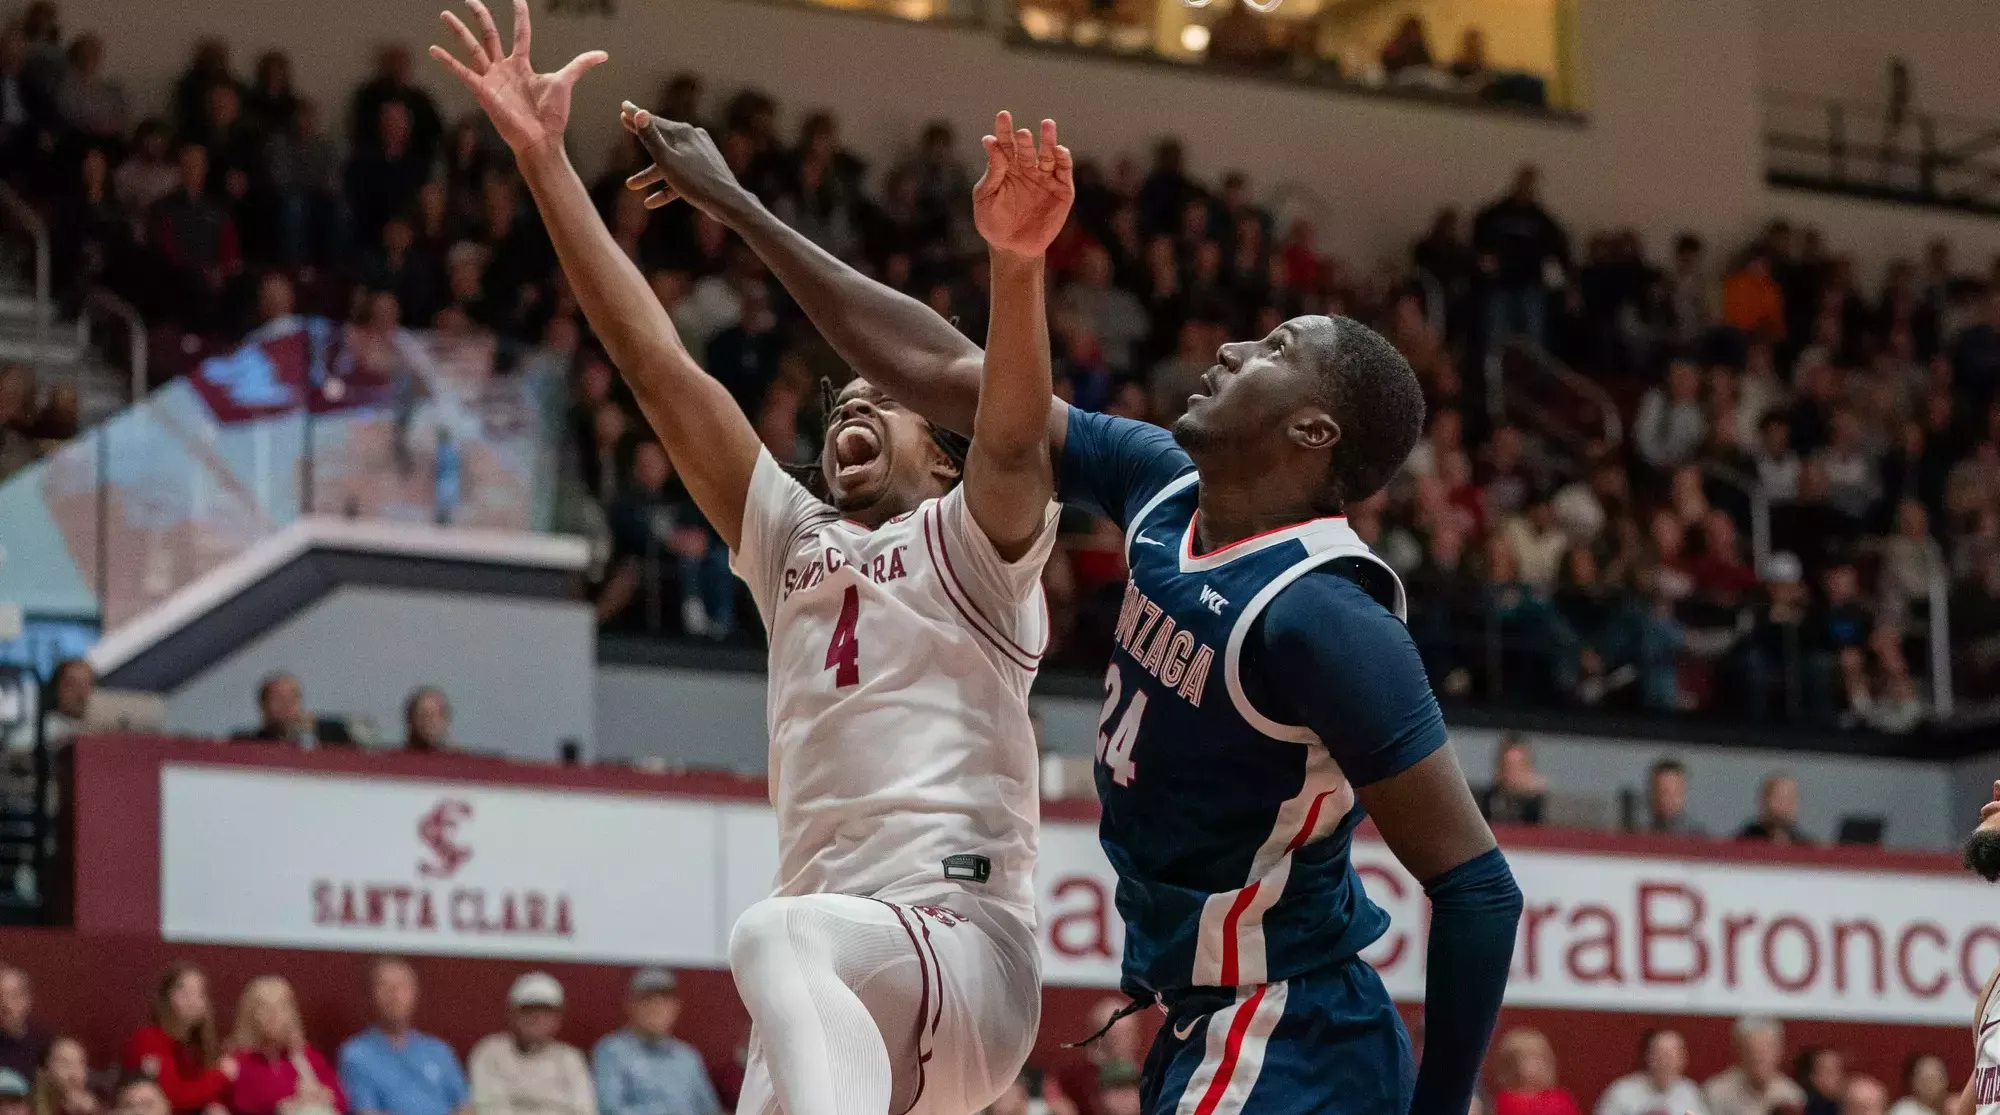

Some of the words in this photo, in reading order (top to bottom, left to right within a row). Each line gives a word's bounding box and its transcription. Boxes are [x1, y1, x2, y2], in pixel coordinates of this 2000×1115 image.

[825, 546, 907, 585] CRA
[1199, 584, 1230, 616] WCC
[824, 583, 860, 689] 4
[1114, 570, 1215, 708] ONZAGA
[1095, 662, 1149, 789] 24
[311, 880, 437, 928] SANTA
[450, 887, 576, 937] CLARA
